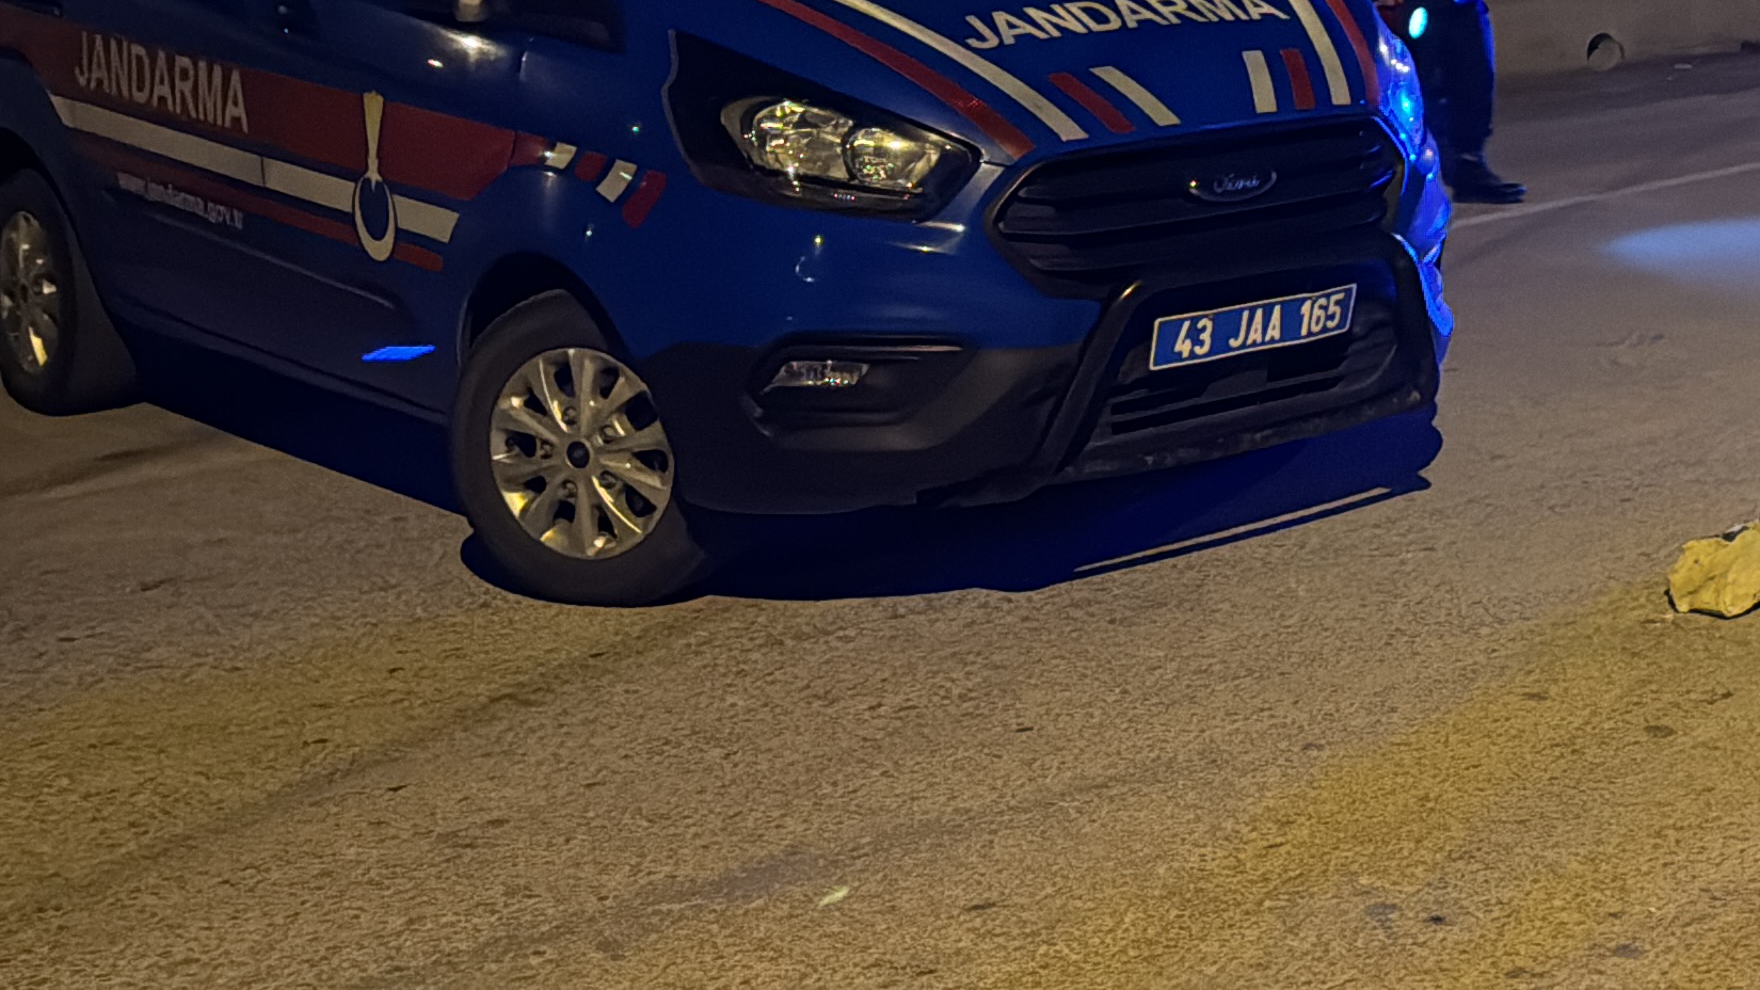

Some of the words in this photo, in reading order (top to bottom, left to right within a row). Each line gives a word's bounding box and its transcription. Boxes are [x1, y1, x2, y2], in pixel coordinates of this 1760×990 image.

[74, 31, 249, 134] JANDARMA
[1174, 318, 1213, 359] 43
[1229, 304, 1281, 349] JAA
[1301, 292, 1346, 337] 165
